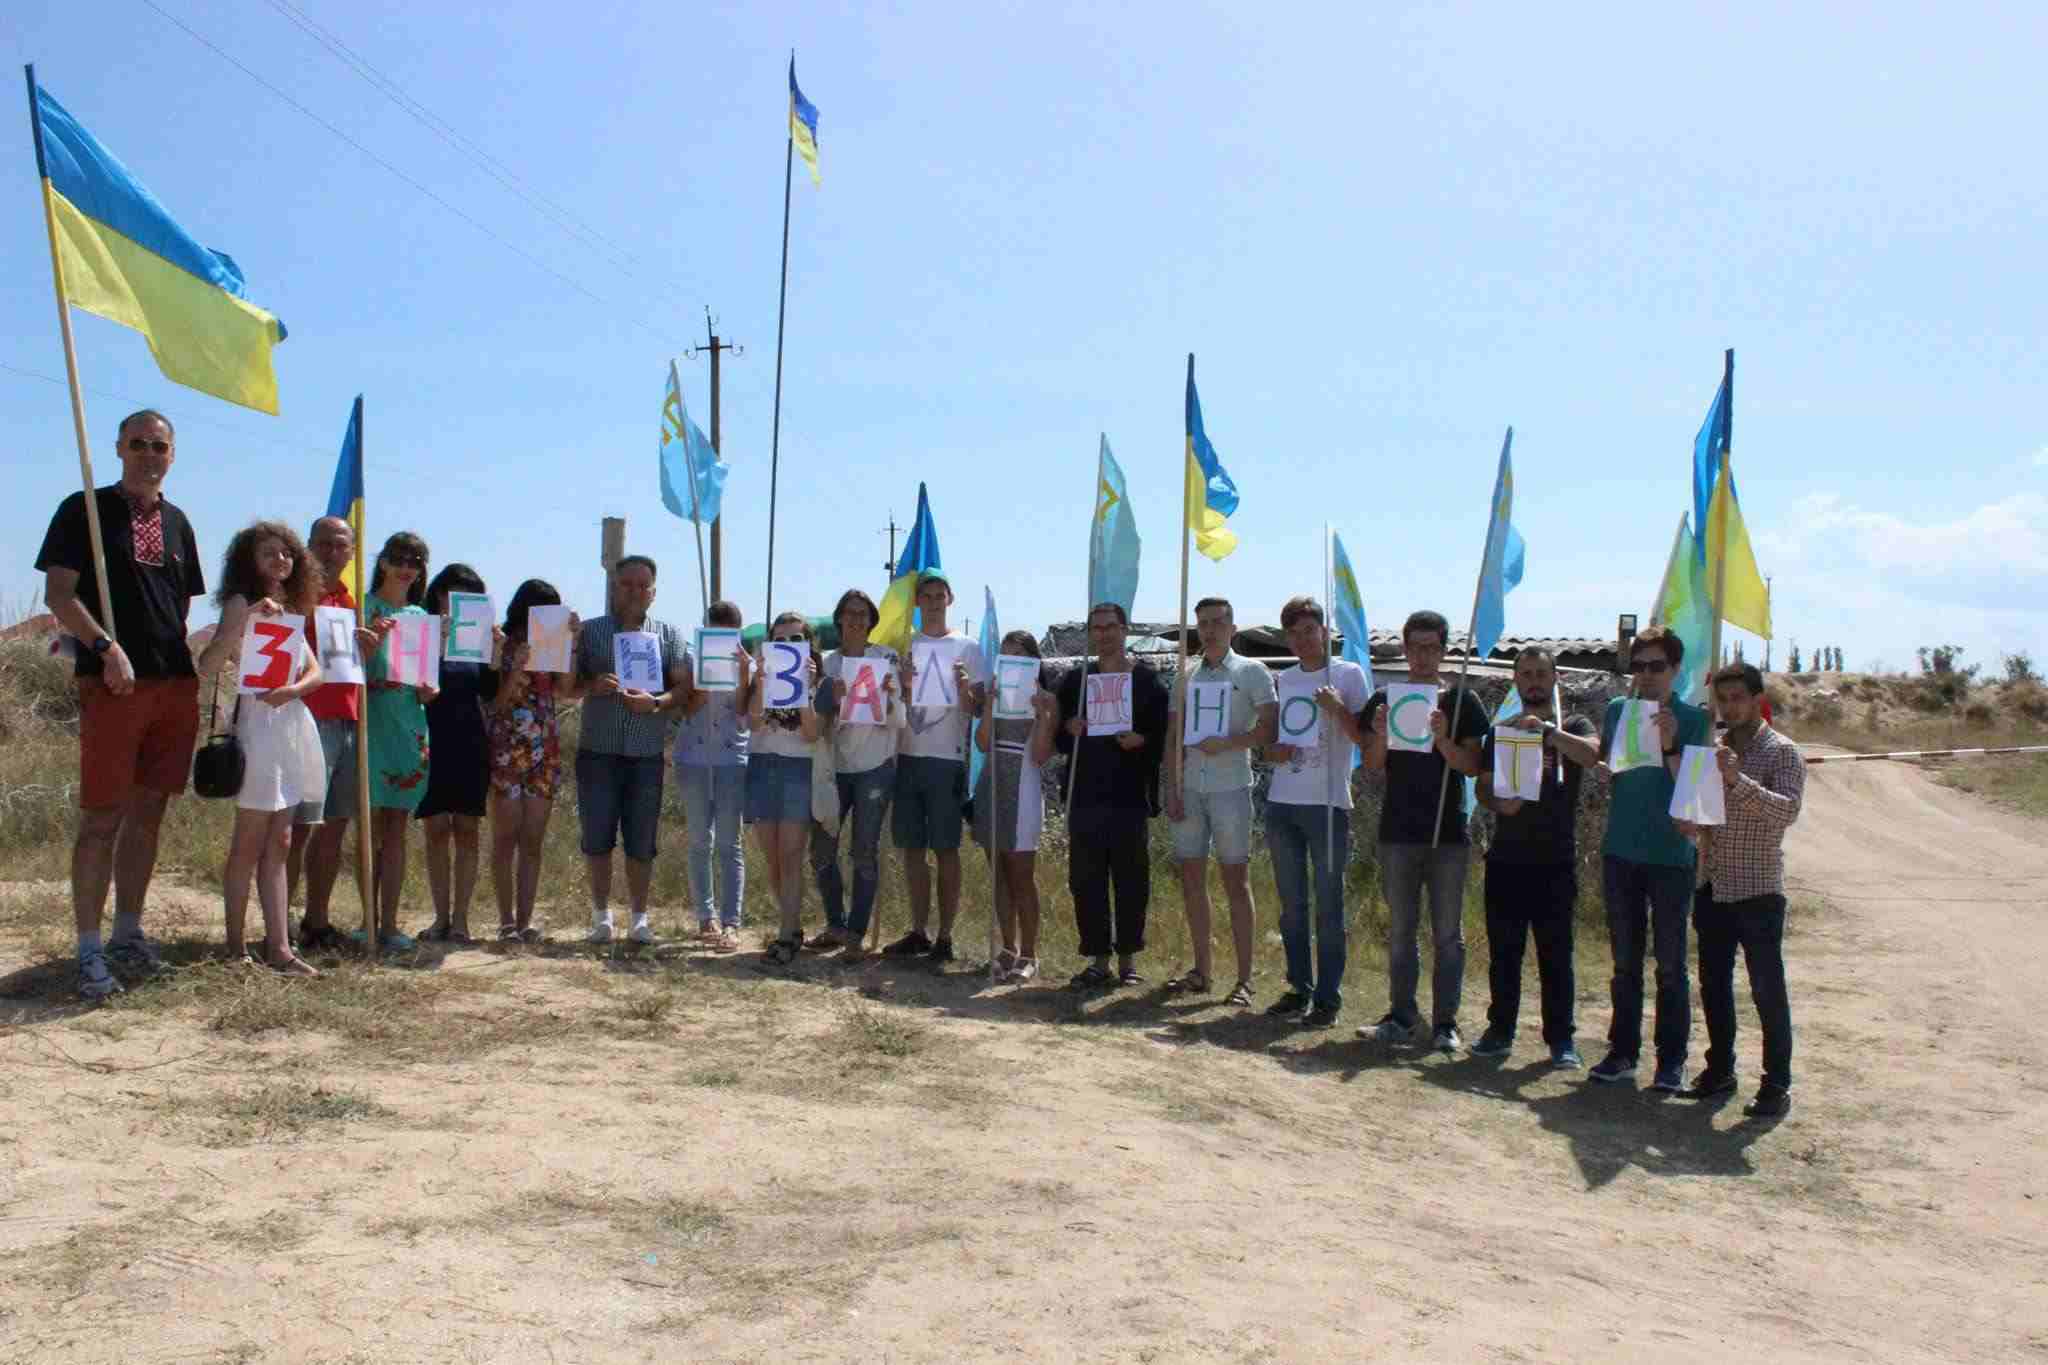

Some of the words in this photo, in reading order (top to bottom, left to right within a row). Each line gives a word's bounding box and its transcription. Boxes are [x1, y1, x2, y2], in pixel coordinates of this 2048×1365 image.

[447, 594, 490, 657] Е
[242, 621, 296, 689] З
[620, 637, 658, 681] Н
[699, 631, 738, 686] Е
[840, 662, 884, 722] А
[1193, 687, 1226, 733] Н
[1388, 692, 1433, 746] С
[1495, 735, 1544, 793] Т
